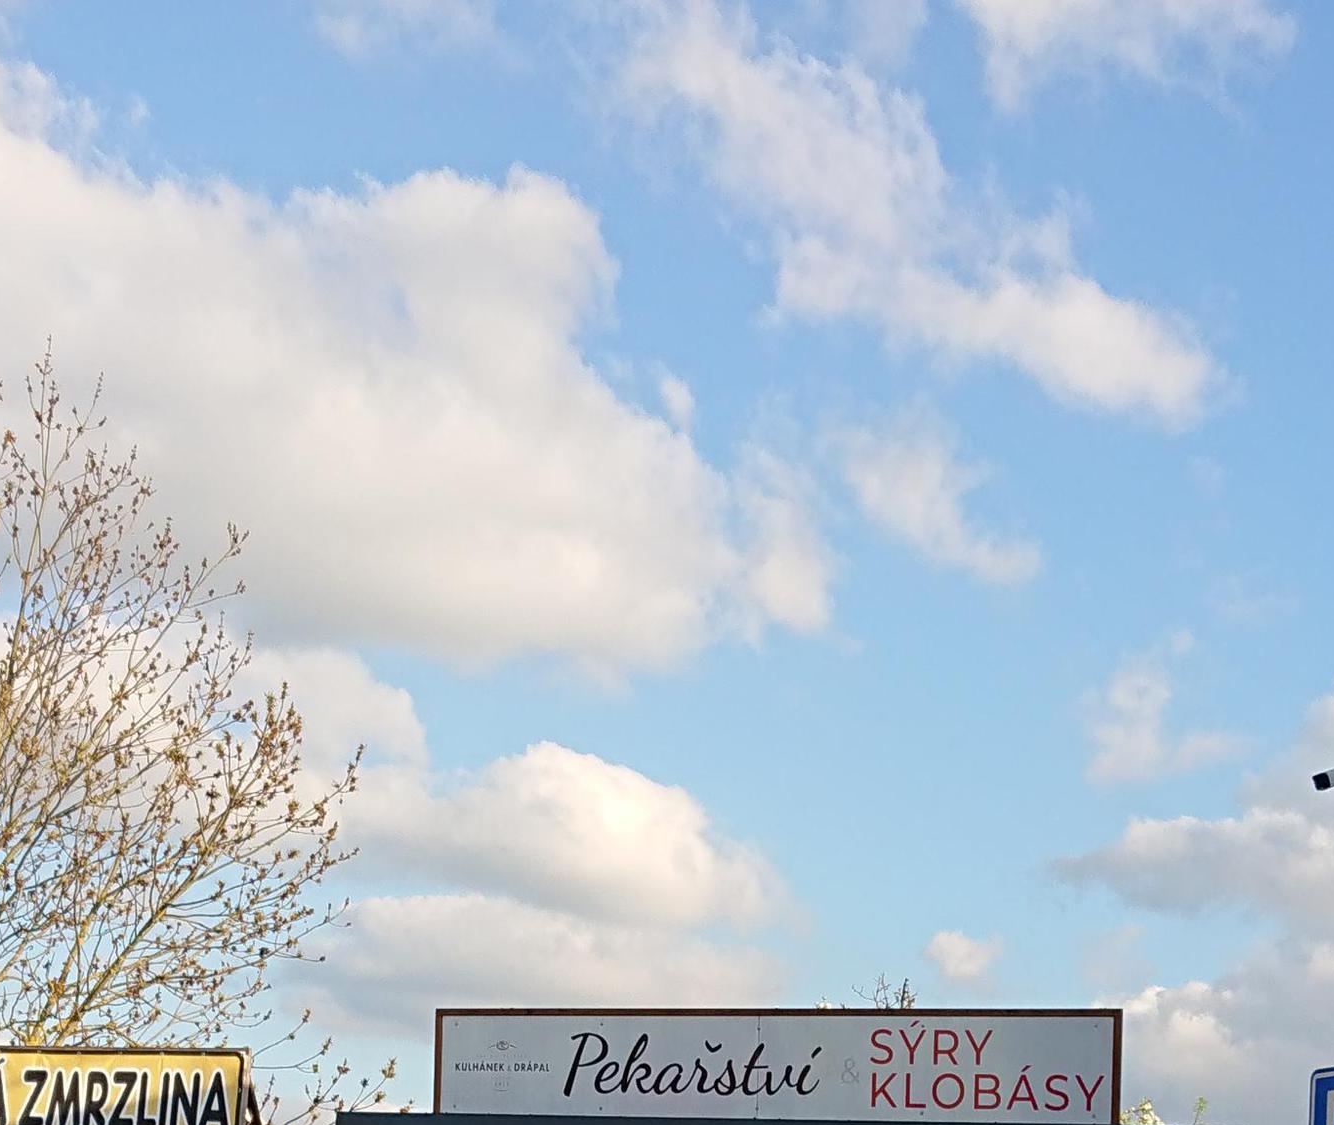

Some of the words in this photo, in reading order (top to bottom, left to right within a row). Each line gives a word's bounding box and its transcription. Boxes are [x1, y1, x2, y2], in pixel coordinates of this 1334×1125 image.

[563, 1031, 823, 1098] Pekařství
[870, 1020, 994, 1064] SÝRY
[455, 1061, 505, 1072] KULHÁNEK
[514, 1061, 550, 1072] DRÁPAL
[871, 1066, 1105, 1112] KLOBÁSY
